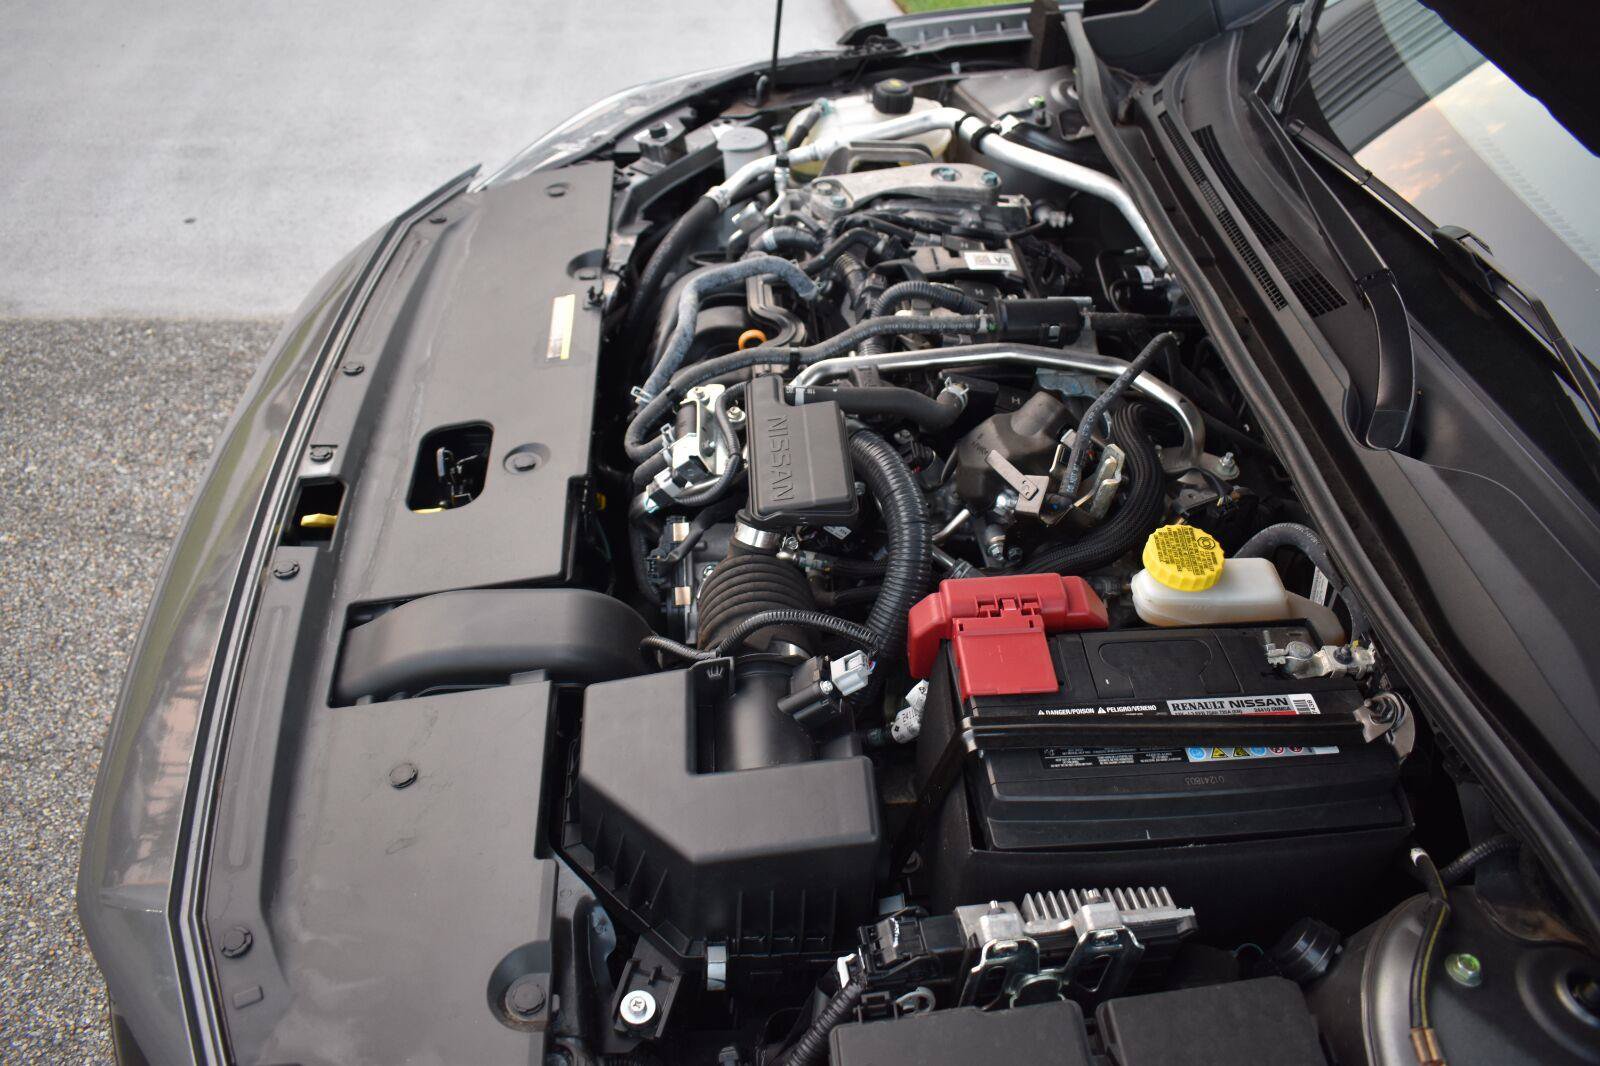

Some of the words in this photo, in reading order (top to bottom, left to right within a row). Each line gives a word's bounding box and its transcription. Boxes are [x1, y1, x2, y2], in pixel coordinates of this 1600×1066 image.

[767, 415, 795, 502] NISSAN
[1106, 704, 1157, 713] PELIGRO/VENENO
[1171, 700, 1225, 711] RENAULT
[1229, 697, 1288, 708] NISSAN
[1045, 707, 1095, 716] DANGER/POISON
